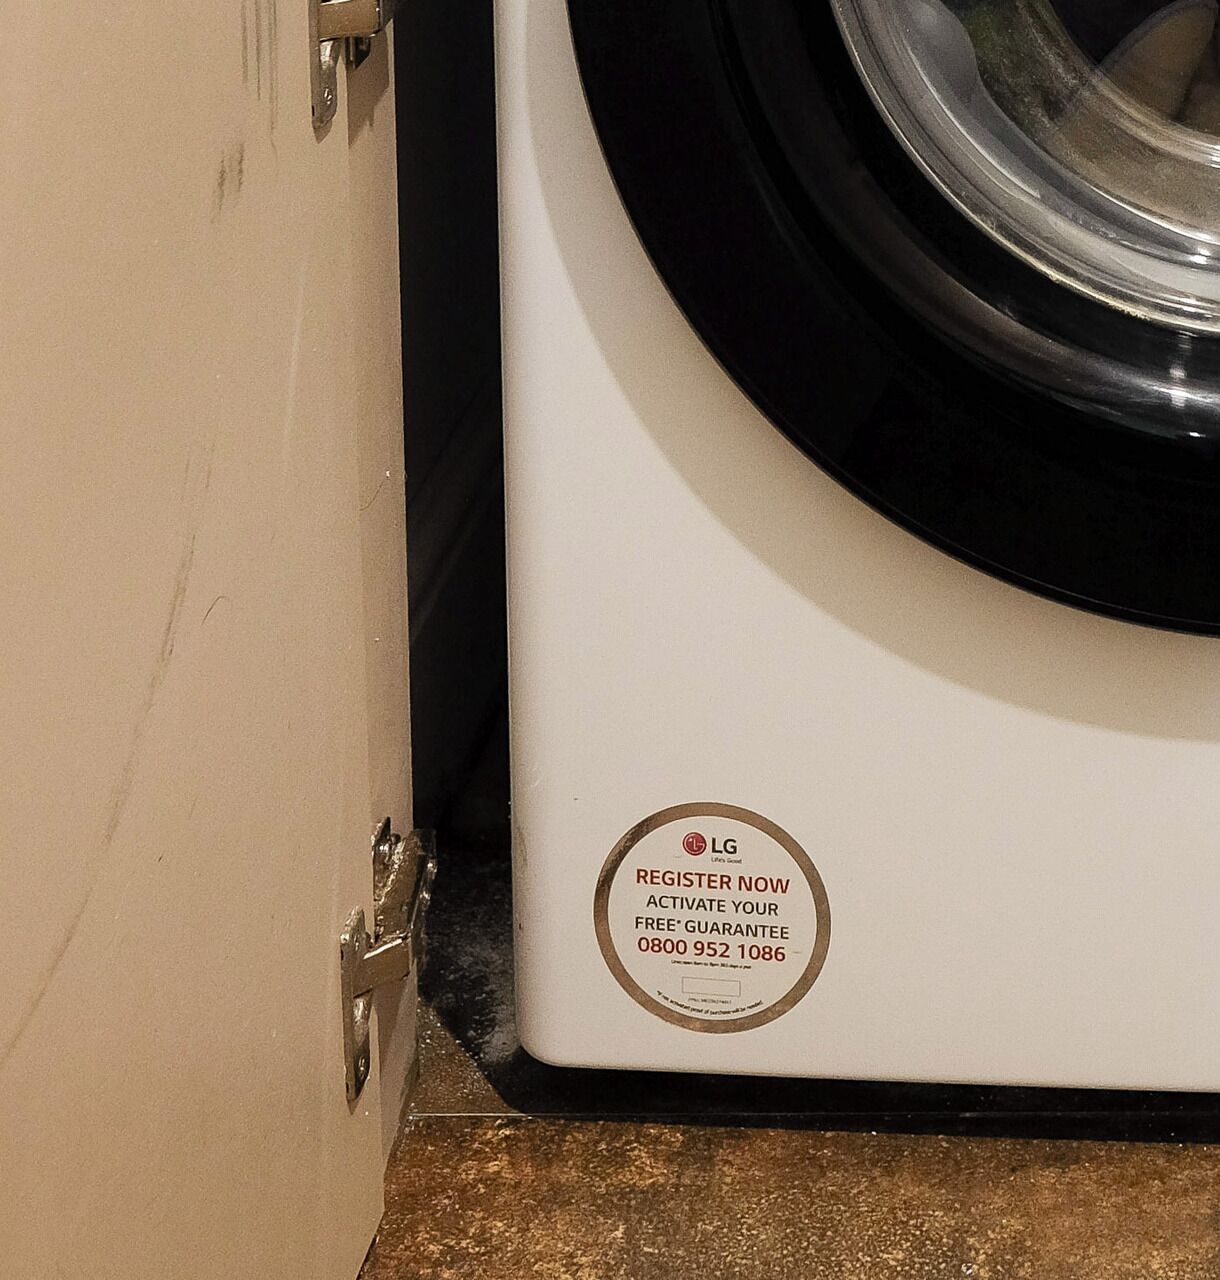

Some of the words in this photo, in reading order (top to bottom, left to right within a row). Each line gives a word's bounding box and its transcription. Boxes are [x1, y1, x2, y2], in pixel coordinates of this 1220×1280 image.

[711, 837, 738, 855] LG
[636, 868, 732, 891] REGISTER
[738, 875, 790, 894] NOW
[646, 894, 727, 914] ACTIVATE
[731, 900, 779, 916] YOUR
[684, 920, 790, 940] GUARANTEE
[637, 936, 688, 956] 0800
[693, 940, 731, 959] 952
[738, 943, 786, 962] 1086
